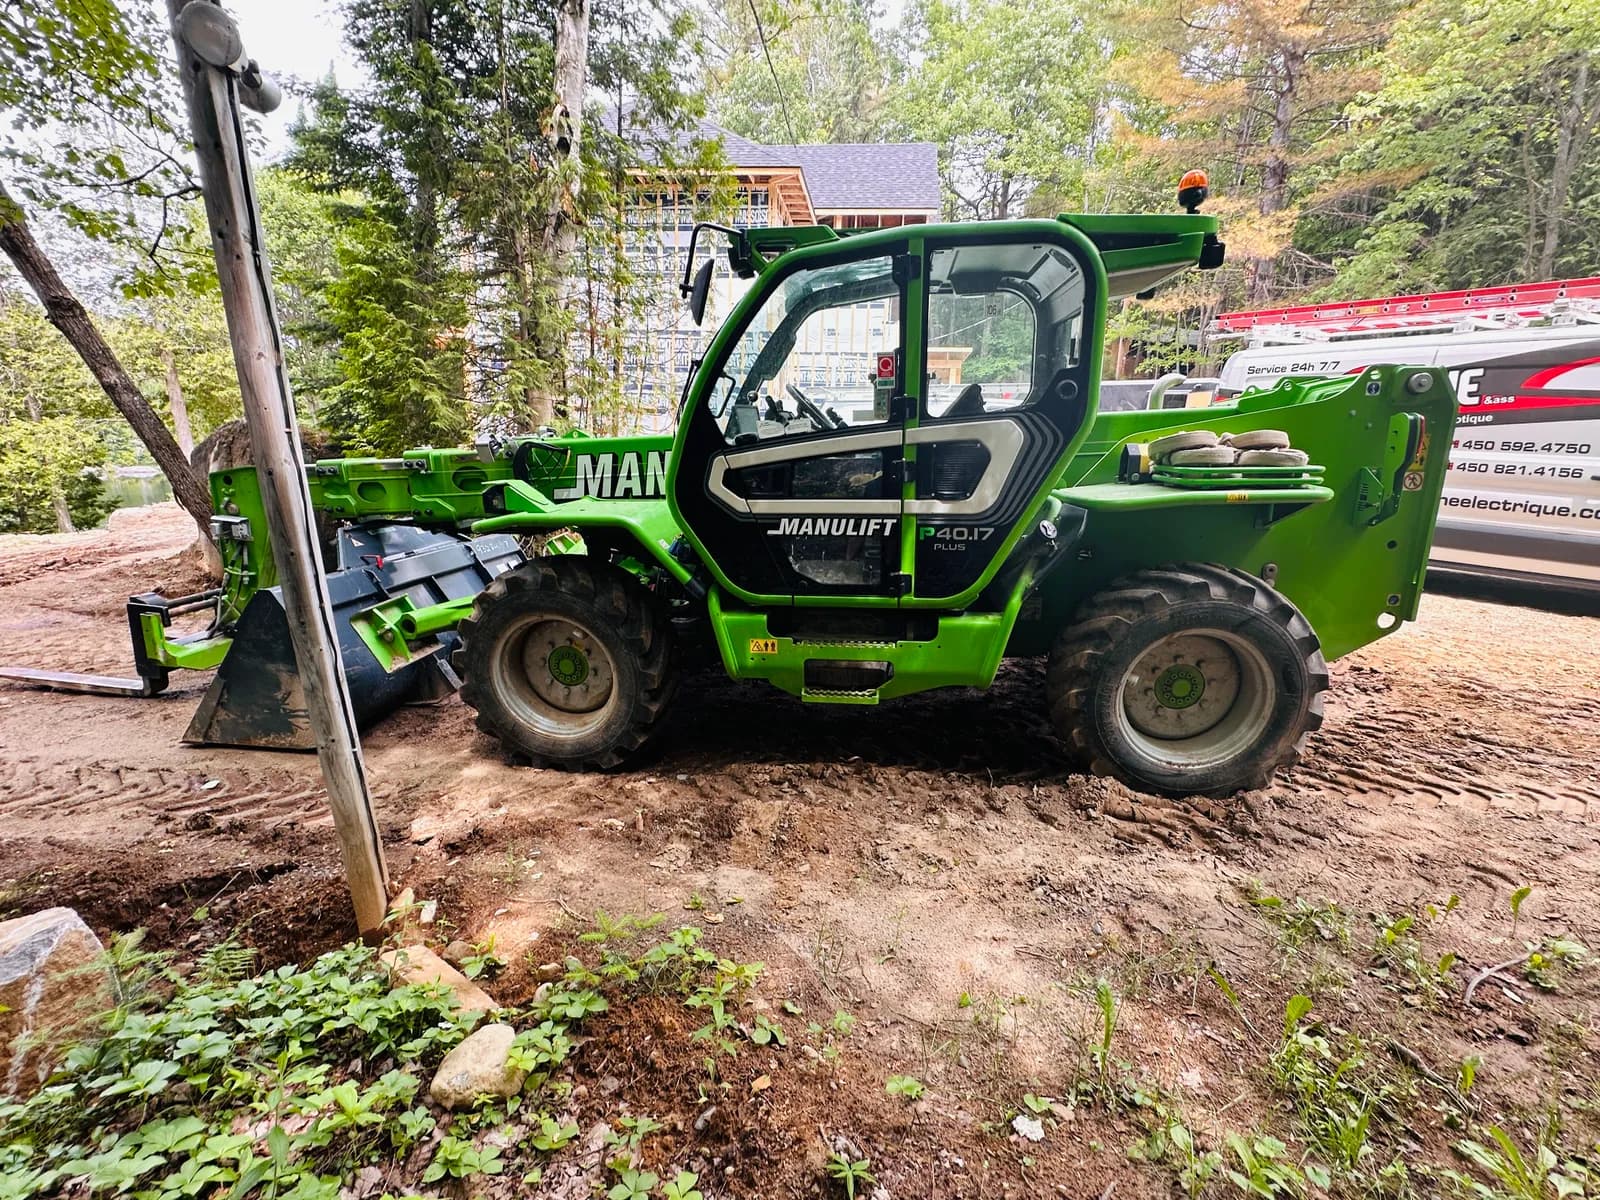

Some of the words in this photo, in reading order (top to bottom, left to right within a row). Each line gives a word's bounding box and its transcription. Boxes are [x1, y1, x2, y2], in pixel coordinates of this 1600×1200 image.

[1247, 364, 1287, 375] Service
[1291, 363, 1315, 372] 24h
[1320, 361, 1341, 371] 7/7
[1483, 395, 1516, 405] &ass
[1462, 440, 1495, 450] 450
[1500, 441, 1592, 454] 592.4750
[553, 451, 672, 500] MAN
[1456, 462, 1489, 473] 450
[1493, 464, 1584, 479] 821.4156
[767, 518, 897, 536] MANULIFT
[919, 527, 995, 541] P40.17
[933, 543, 966, 551] PLUS
